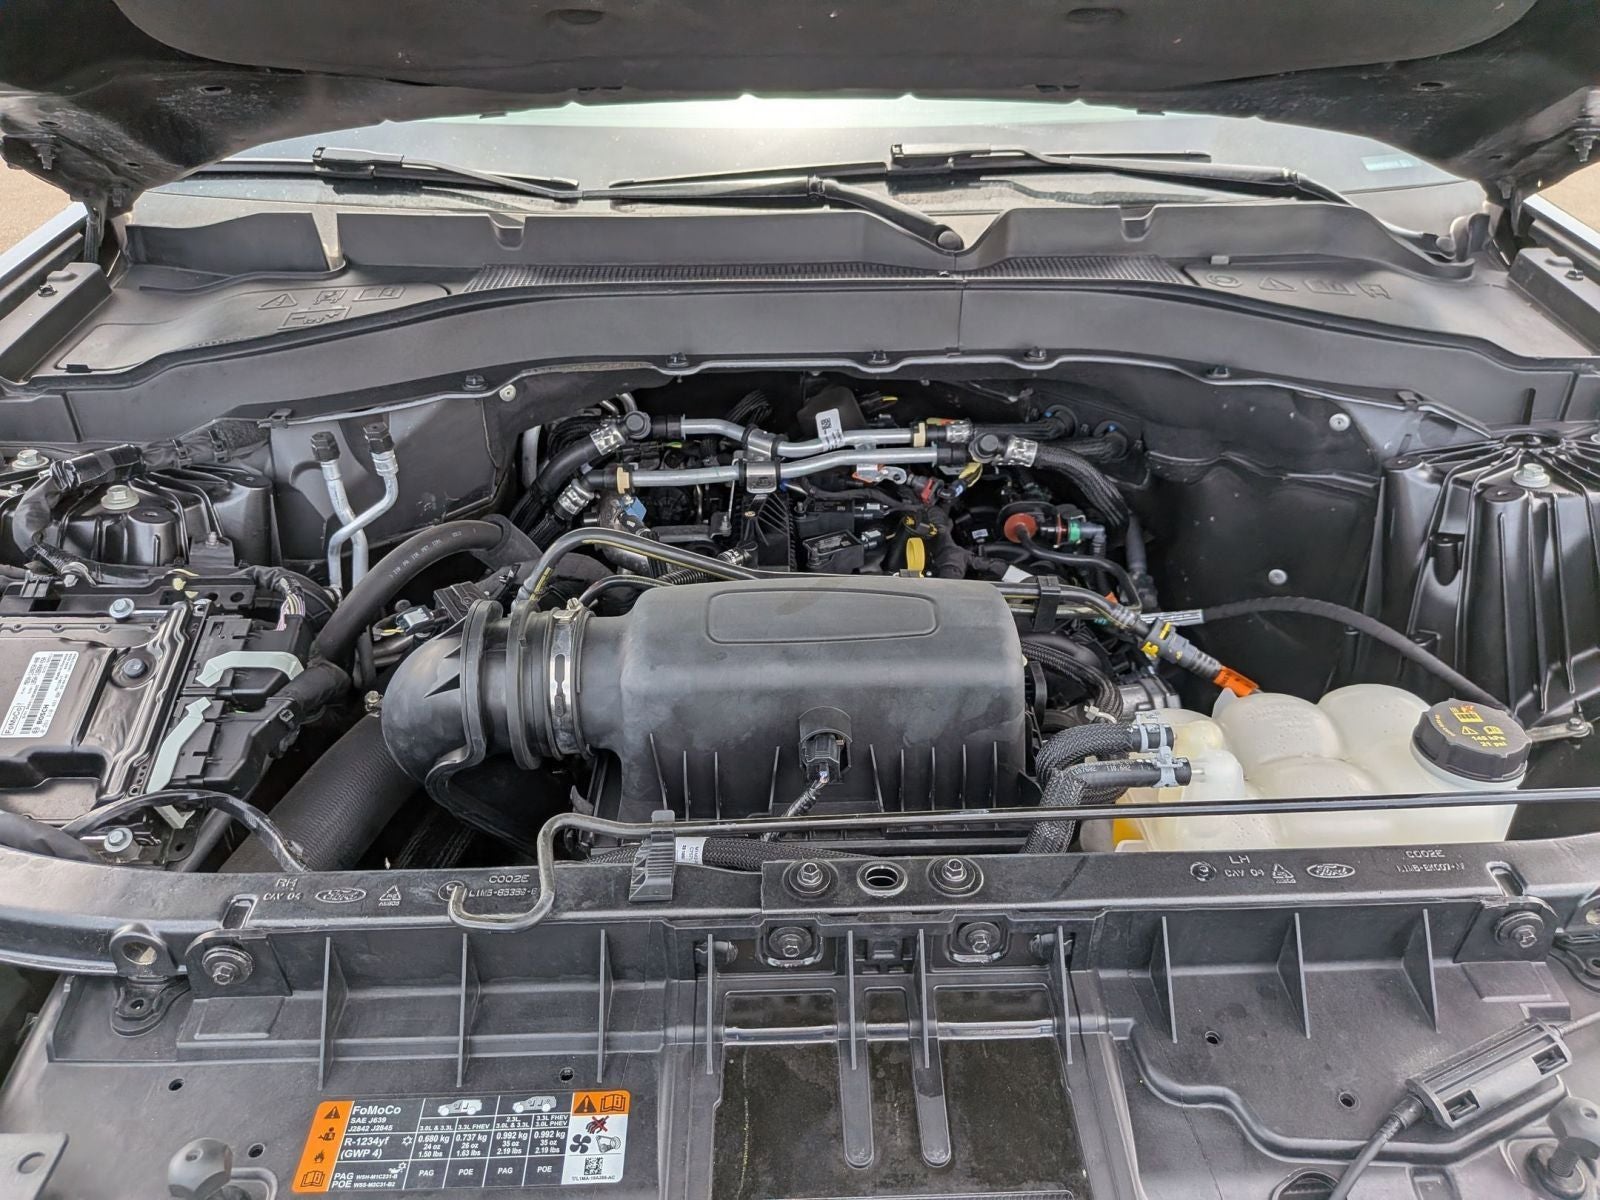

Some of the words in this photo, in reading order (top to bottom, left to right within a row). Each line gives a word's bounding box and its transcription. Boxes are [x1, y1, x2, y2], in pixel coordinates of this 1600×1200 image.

[36, 704, 49, 724] BOSCH
[1229, 855, 1250, 864] LH
[1313, 865, 1350, 877] Ford
[352, 1105, 402, 1115] FoMoCo
[441, 1134, 450, 1144] kg
[456, 1134, 476, 1142] 0.737
[478, 1133, 487, 1142] kg
[518, 1131, 528, 1140] kg
[556, 1130, 566, 1139] kg
[344, 1136, 390, 1147] R-1234yf
[340, 1149, 370, 1160] (GWP
[372, 1149, 382, 1159] 4)
[331, 1180, 352, 1188] POE
